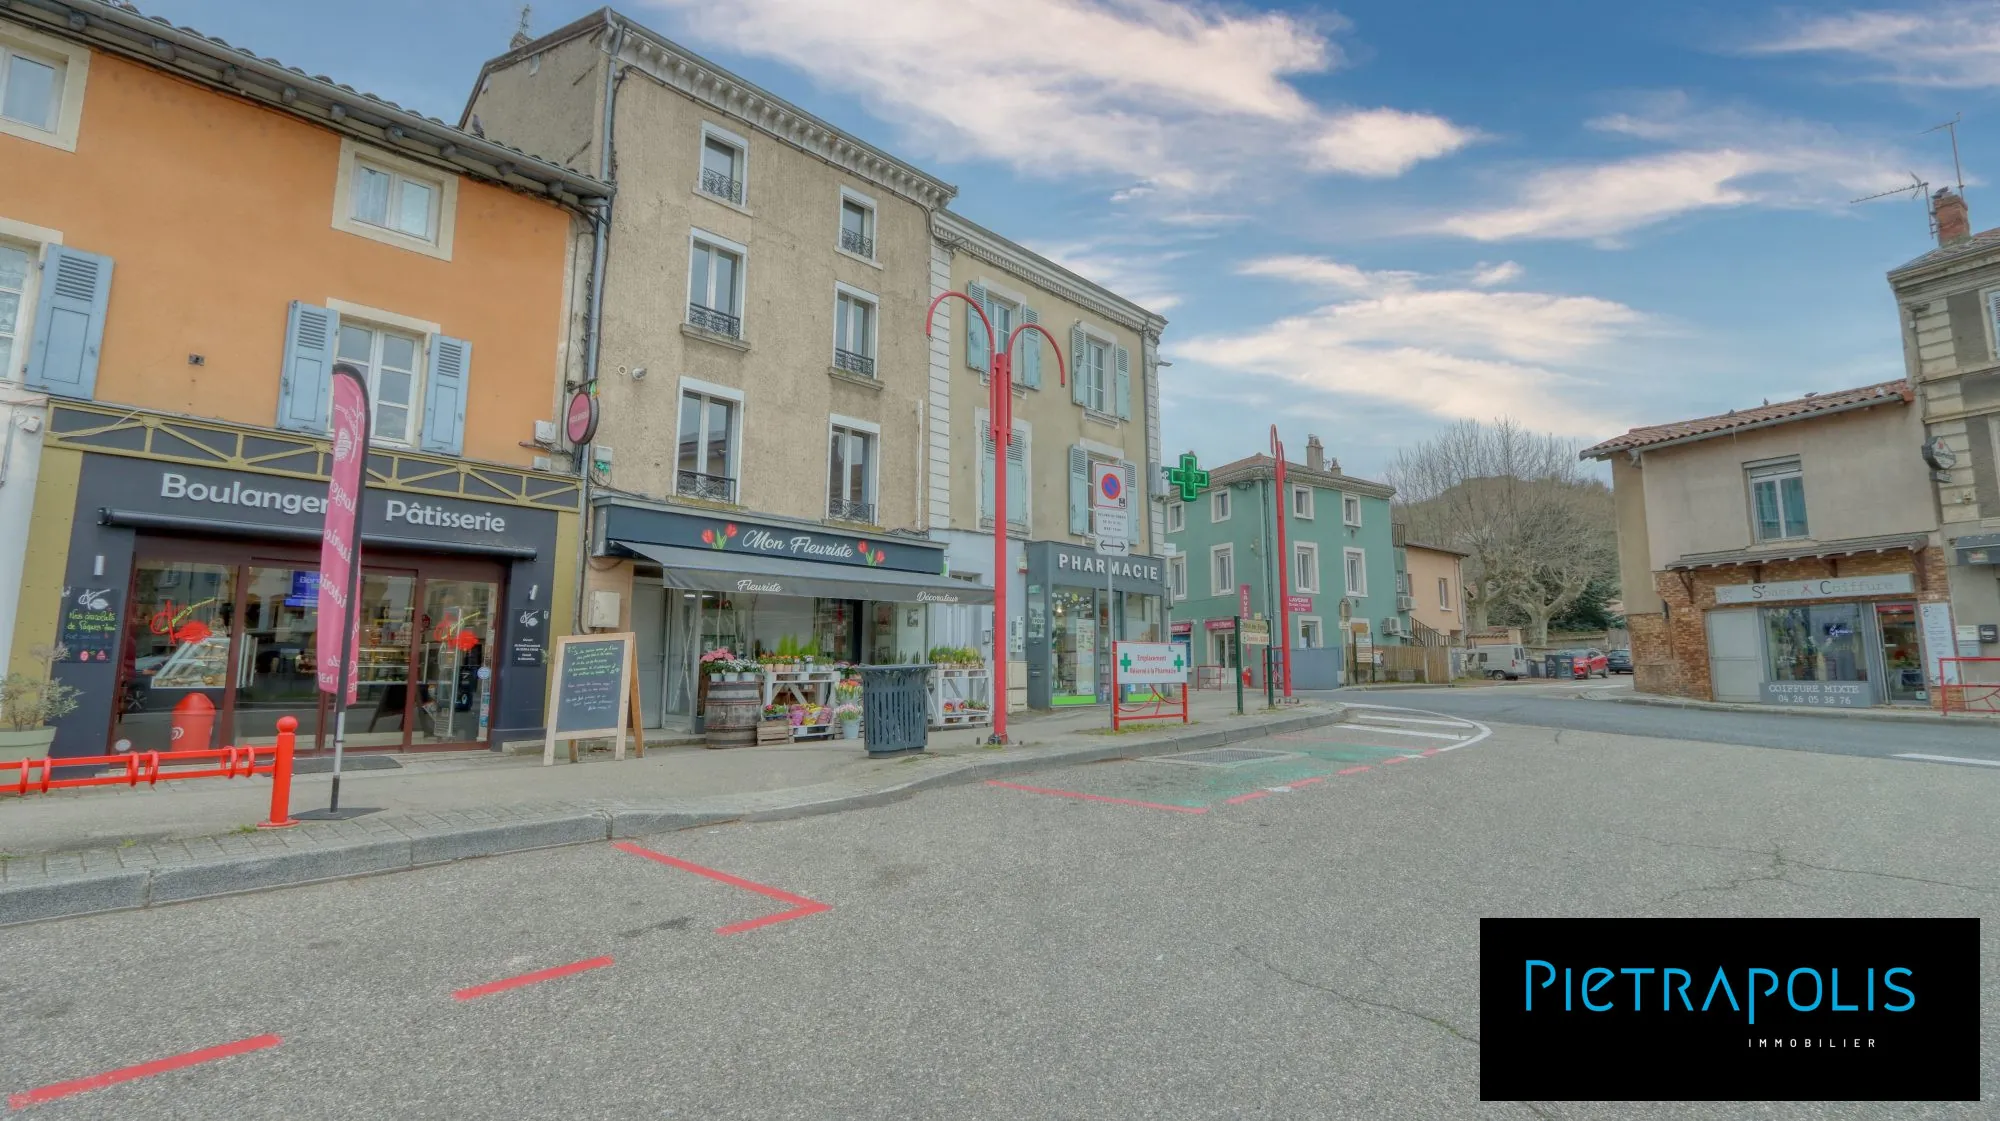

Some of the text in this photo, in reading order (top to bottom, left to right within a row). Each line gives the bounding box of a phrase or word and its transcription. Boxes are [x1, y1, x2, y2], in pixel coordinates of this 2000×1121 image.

[161, 472, 329, 515] Boulanger
[386, 499, 506, 532] Pâtisserie
[743, 530, 853, 557] Mon Fleuriste
[1059, 554, 1158, 580] PHARMACIE
[737, 580, 782, 592] Fleuriste
[1820, 580, 1895, 595] Coiffure
[1769, 684, 1860, 694] COIFFURE MIXTE
[1778, 694, 1851, 705] 04 26 05 38 76
